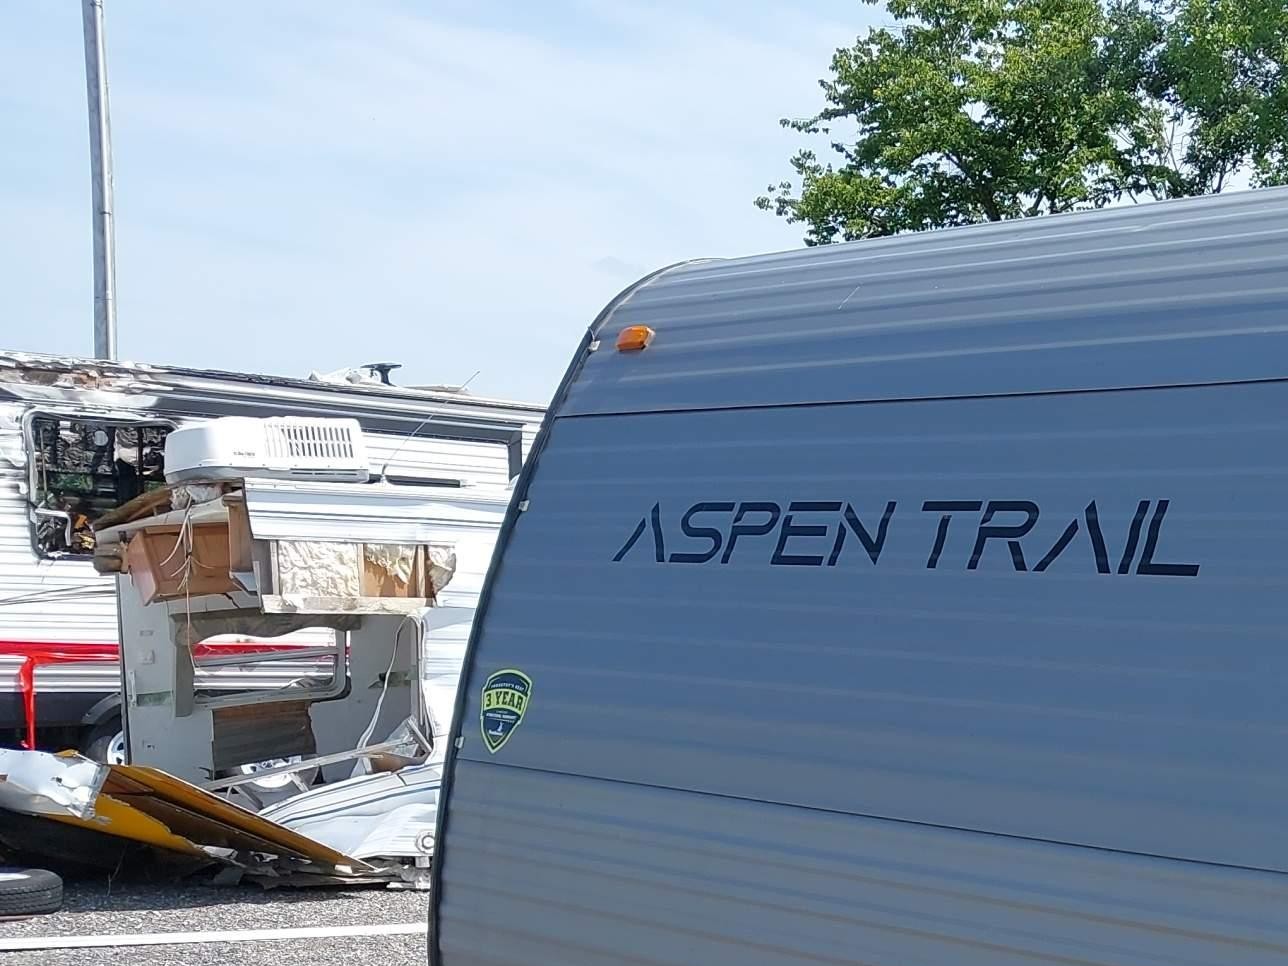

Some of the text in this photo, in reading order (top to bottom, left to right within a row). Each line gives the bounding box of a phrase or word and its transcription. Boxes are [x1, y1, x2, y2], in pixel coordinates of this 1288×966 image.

[611, 499, 1201, 578] ASPEN TRAIL
[485, 690, 524, 711] 3 YEAR
